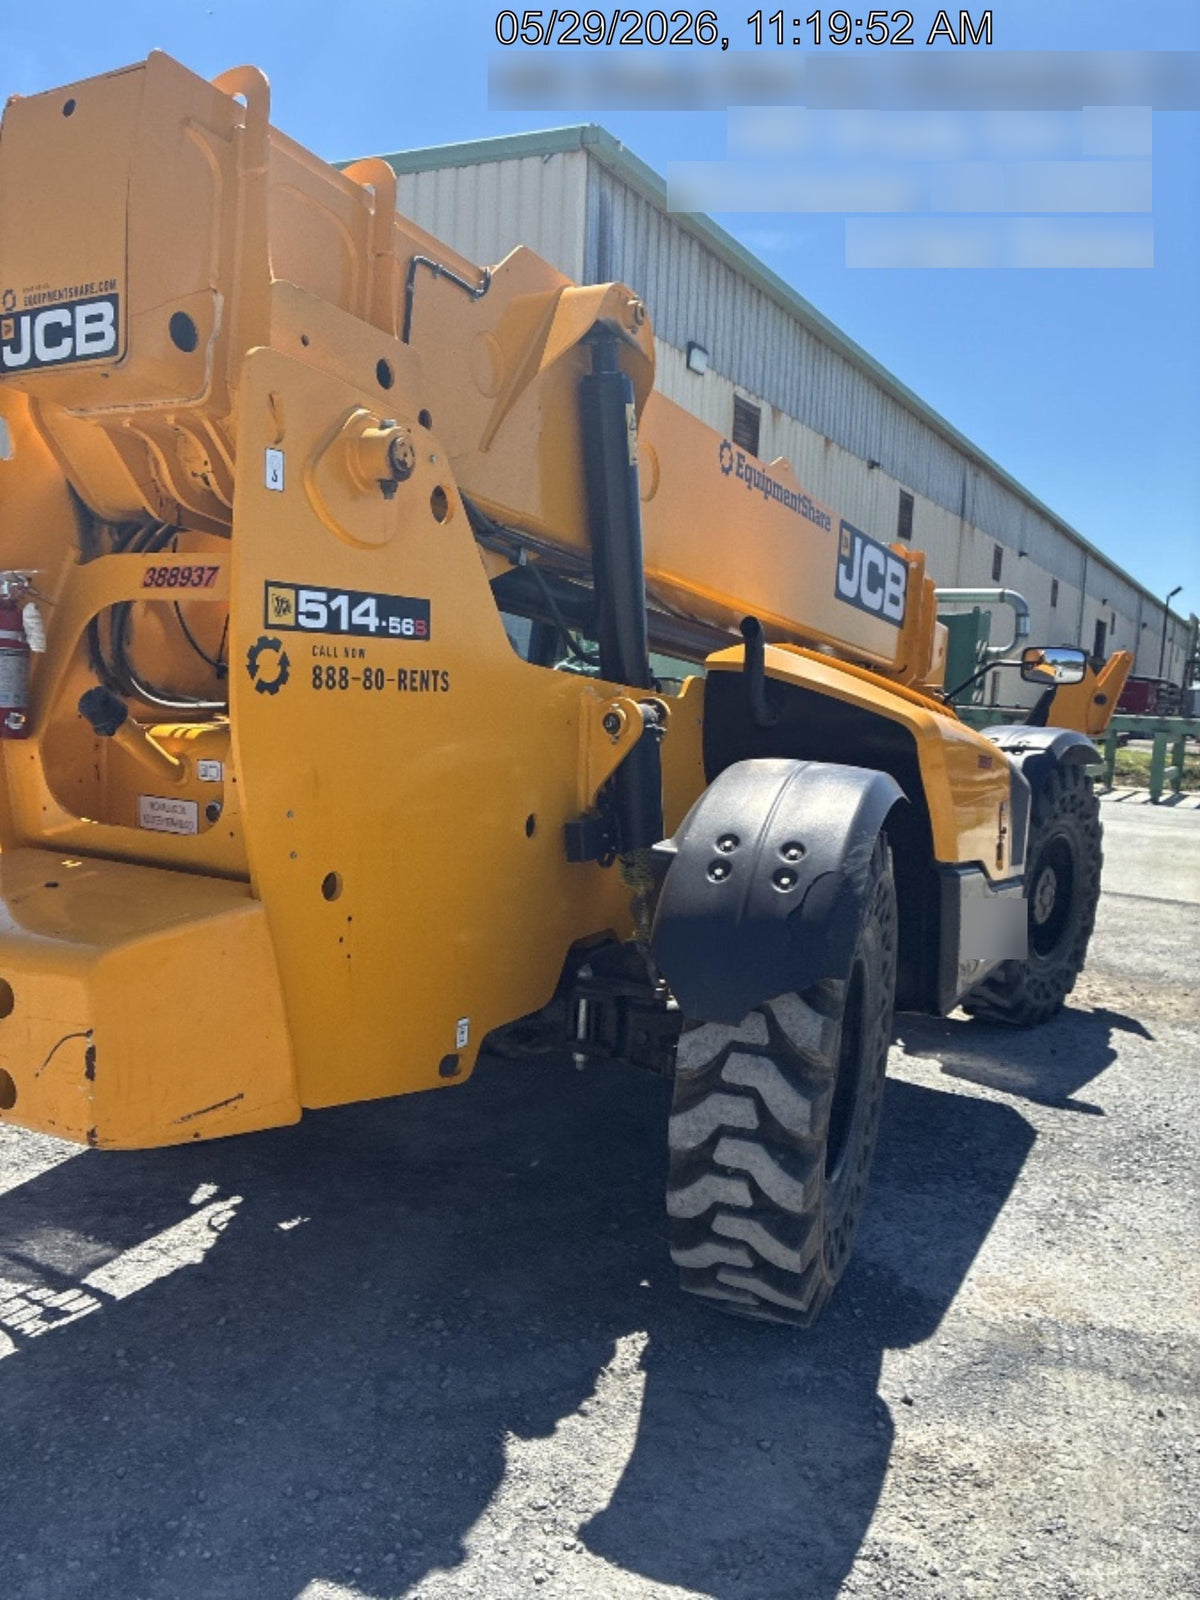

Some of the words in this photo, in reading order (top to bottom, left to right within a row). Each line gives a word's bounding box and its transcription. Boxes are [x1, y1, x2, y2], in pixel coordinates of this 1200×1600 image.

[2, 301, 116, 367] JCB
[735, 451, 831, 532] EquipmentShare
[143, 566, 219, 588] 388937
[838, 536, 906, 622] JCB
[311, 644, 339, 659] CALL
[311, 664, 451, 692] 888-80-RENTS
